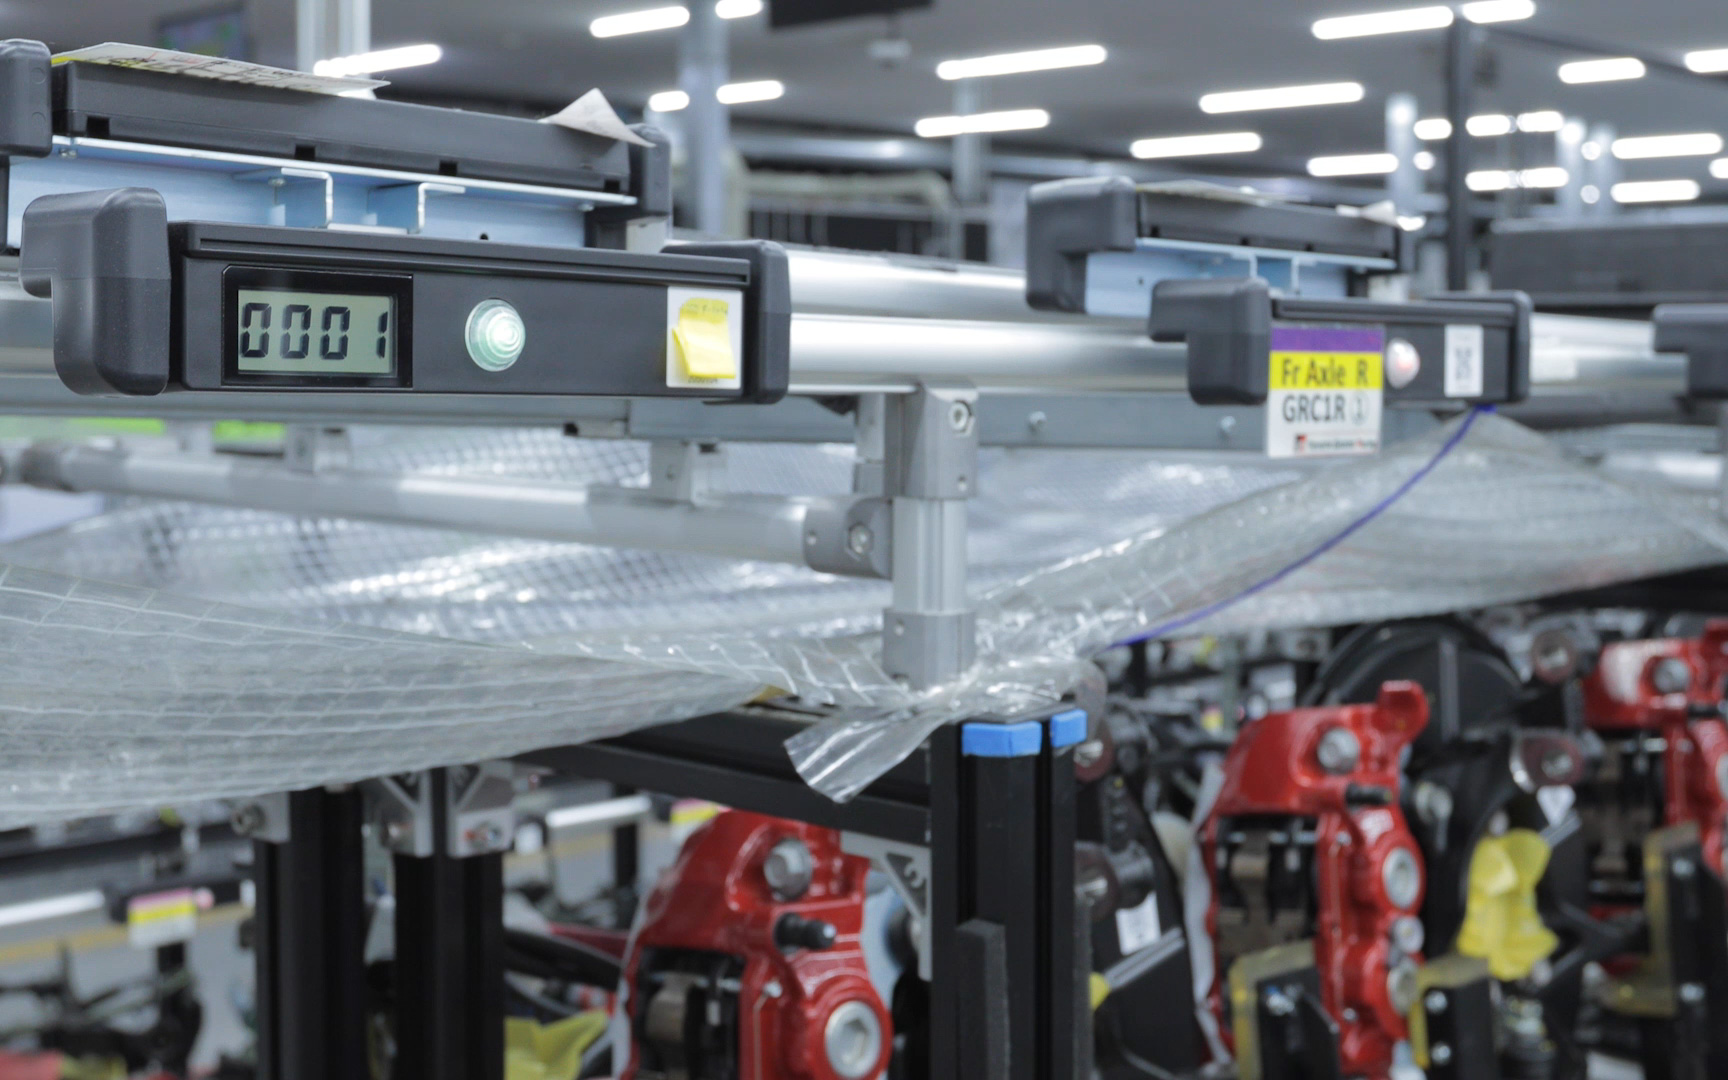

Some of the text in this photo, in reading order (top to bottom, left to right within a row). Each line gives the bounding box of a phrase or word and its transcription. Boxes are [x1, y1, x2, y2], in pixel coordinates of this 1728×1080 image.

[240, 302, 388, 360] 0001
[1281, 357, 1369, 386] Fr Axle R
[1282, 394, 1346, 422] GRC1R
